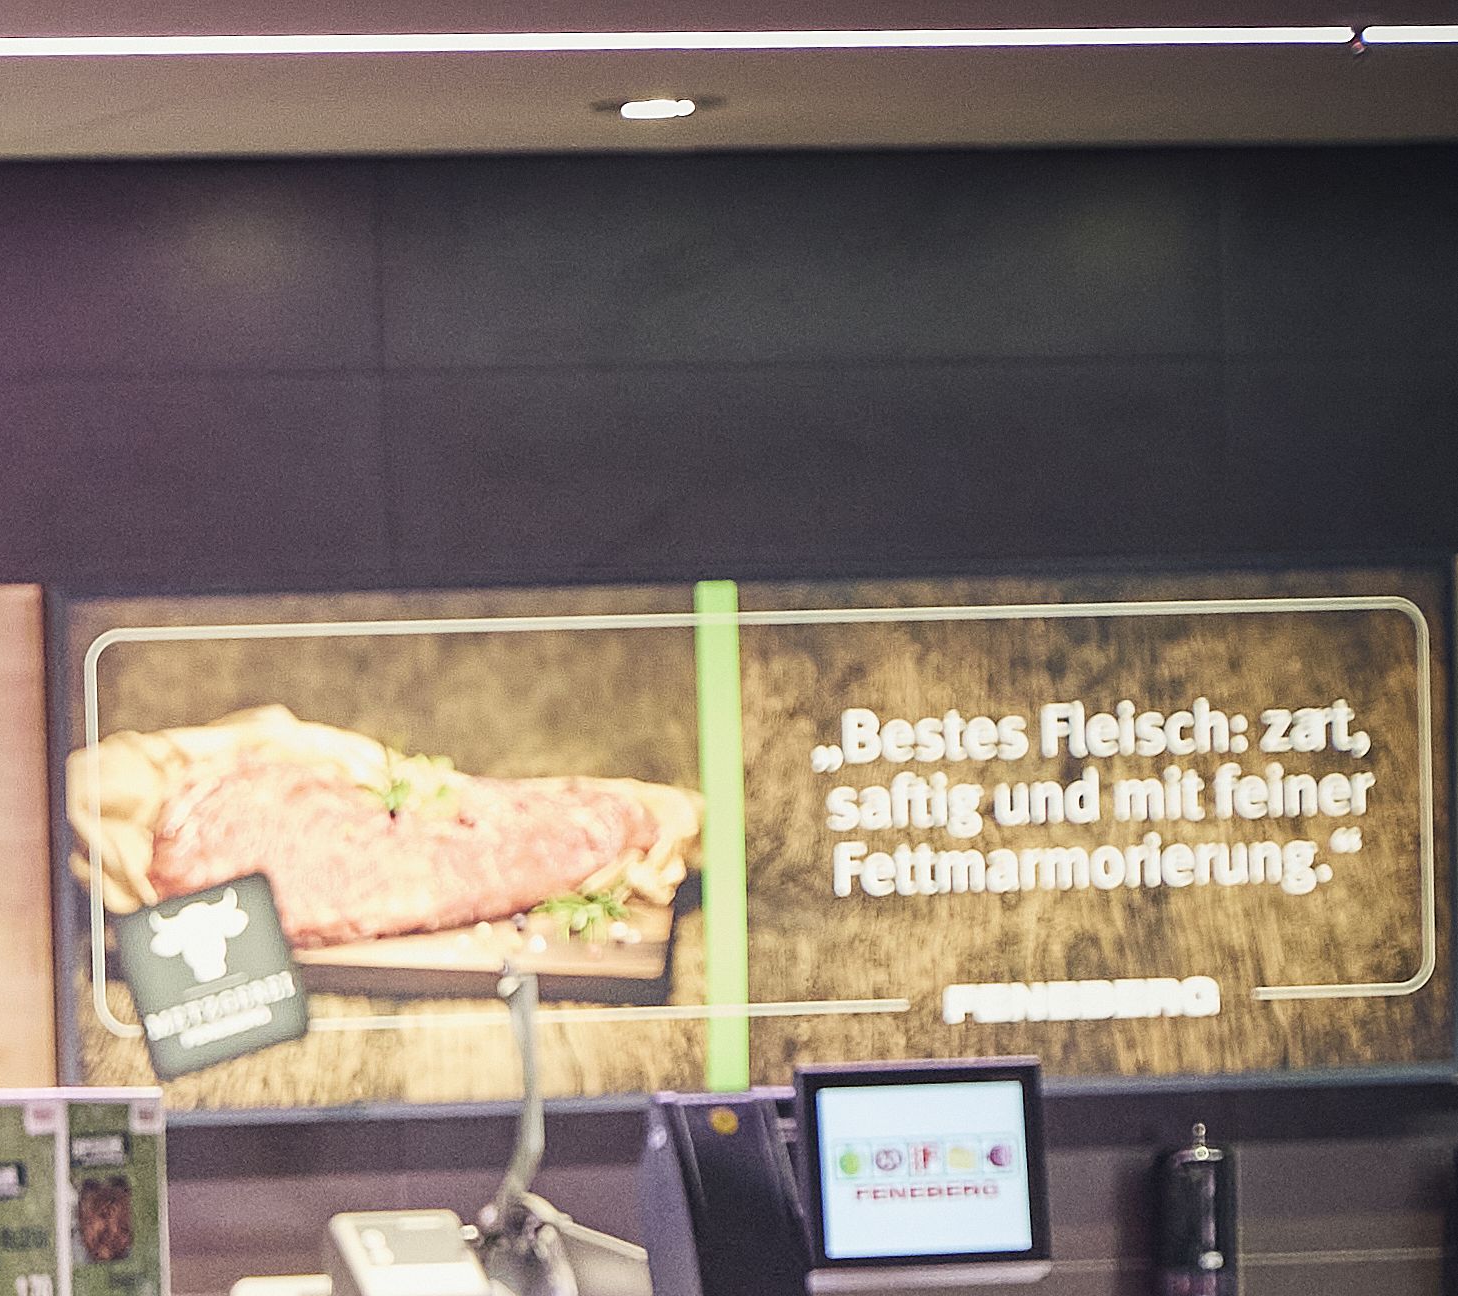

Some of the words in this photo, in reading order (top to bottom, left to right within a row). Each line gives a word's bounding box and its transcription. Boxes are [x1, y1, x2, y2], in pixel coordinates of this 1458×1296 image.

[1040, 698, 1249, 758] Fleisch:
[1260, 699, 1372, 758] zart,
[826, 771, 982, 839] saftig
[994, 766, 1100, 825] und
[1114, 765, 1205, 823] mit
[1214, 763, 1375, 818] feiner
[856, 1180, 1000, 1201] FENEBERG
